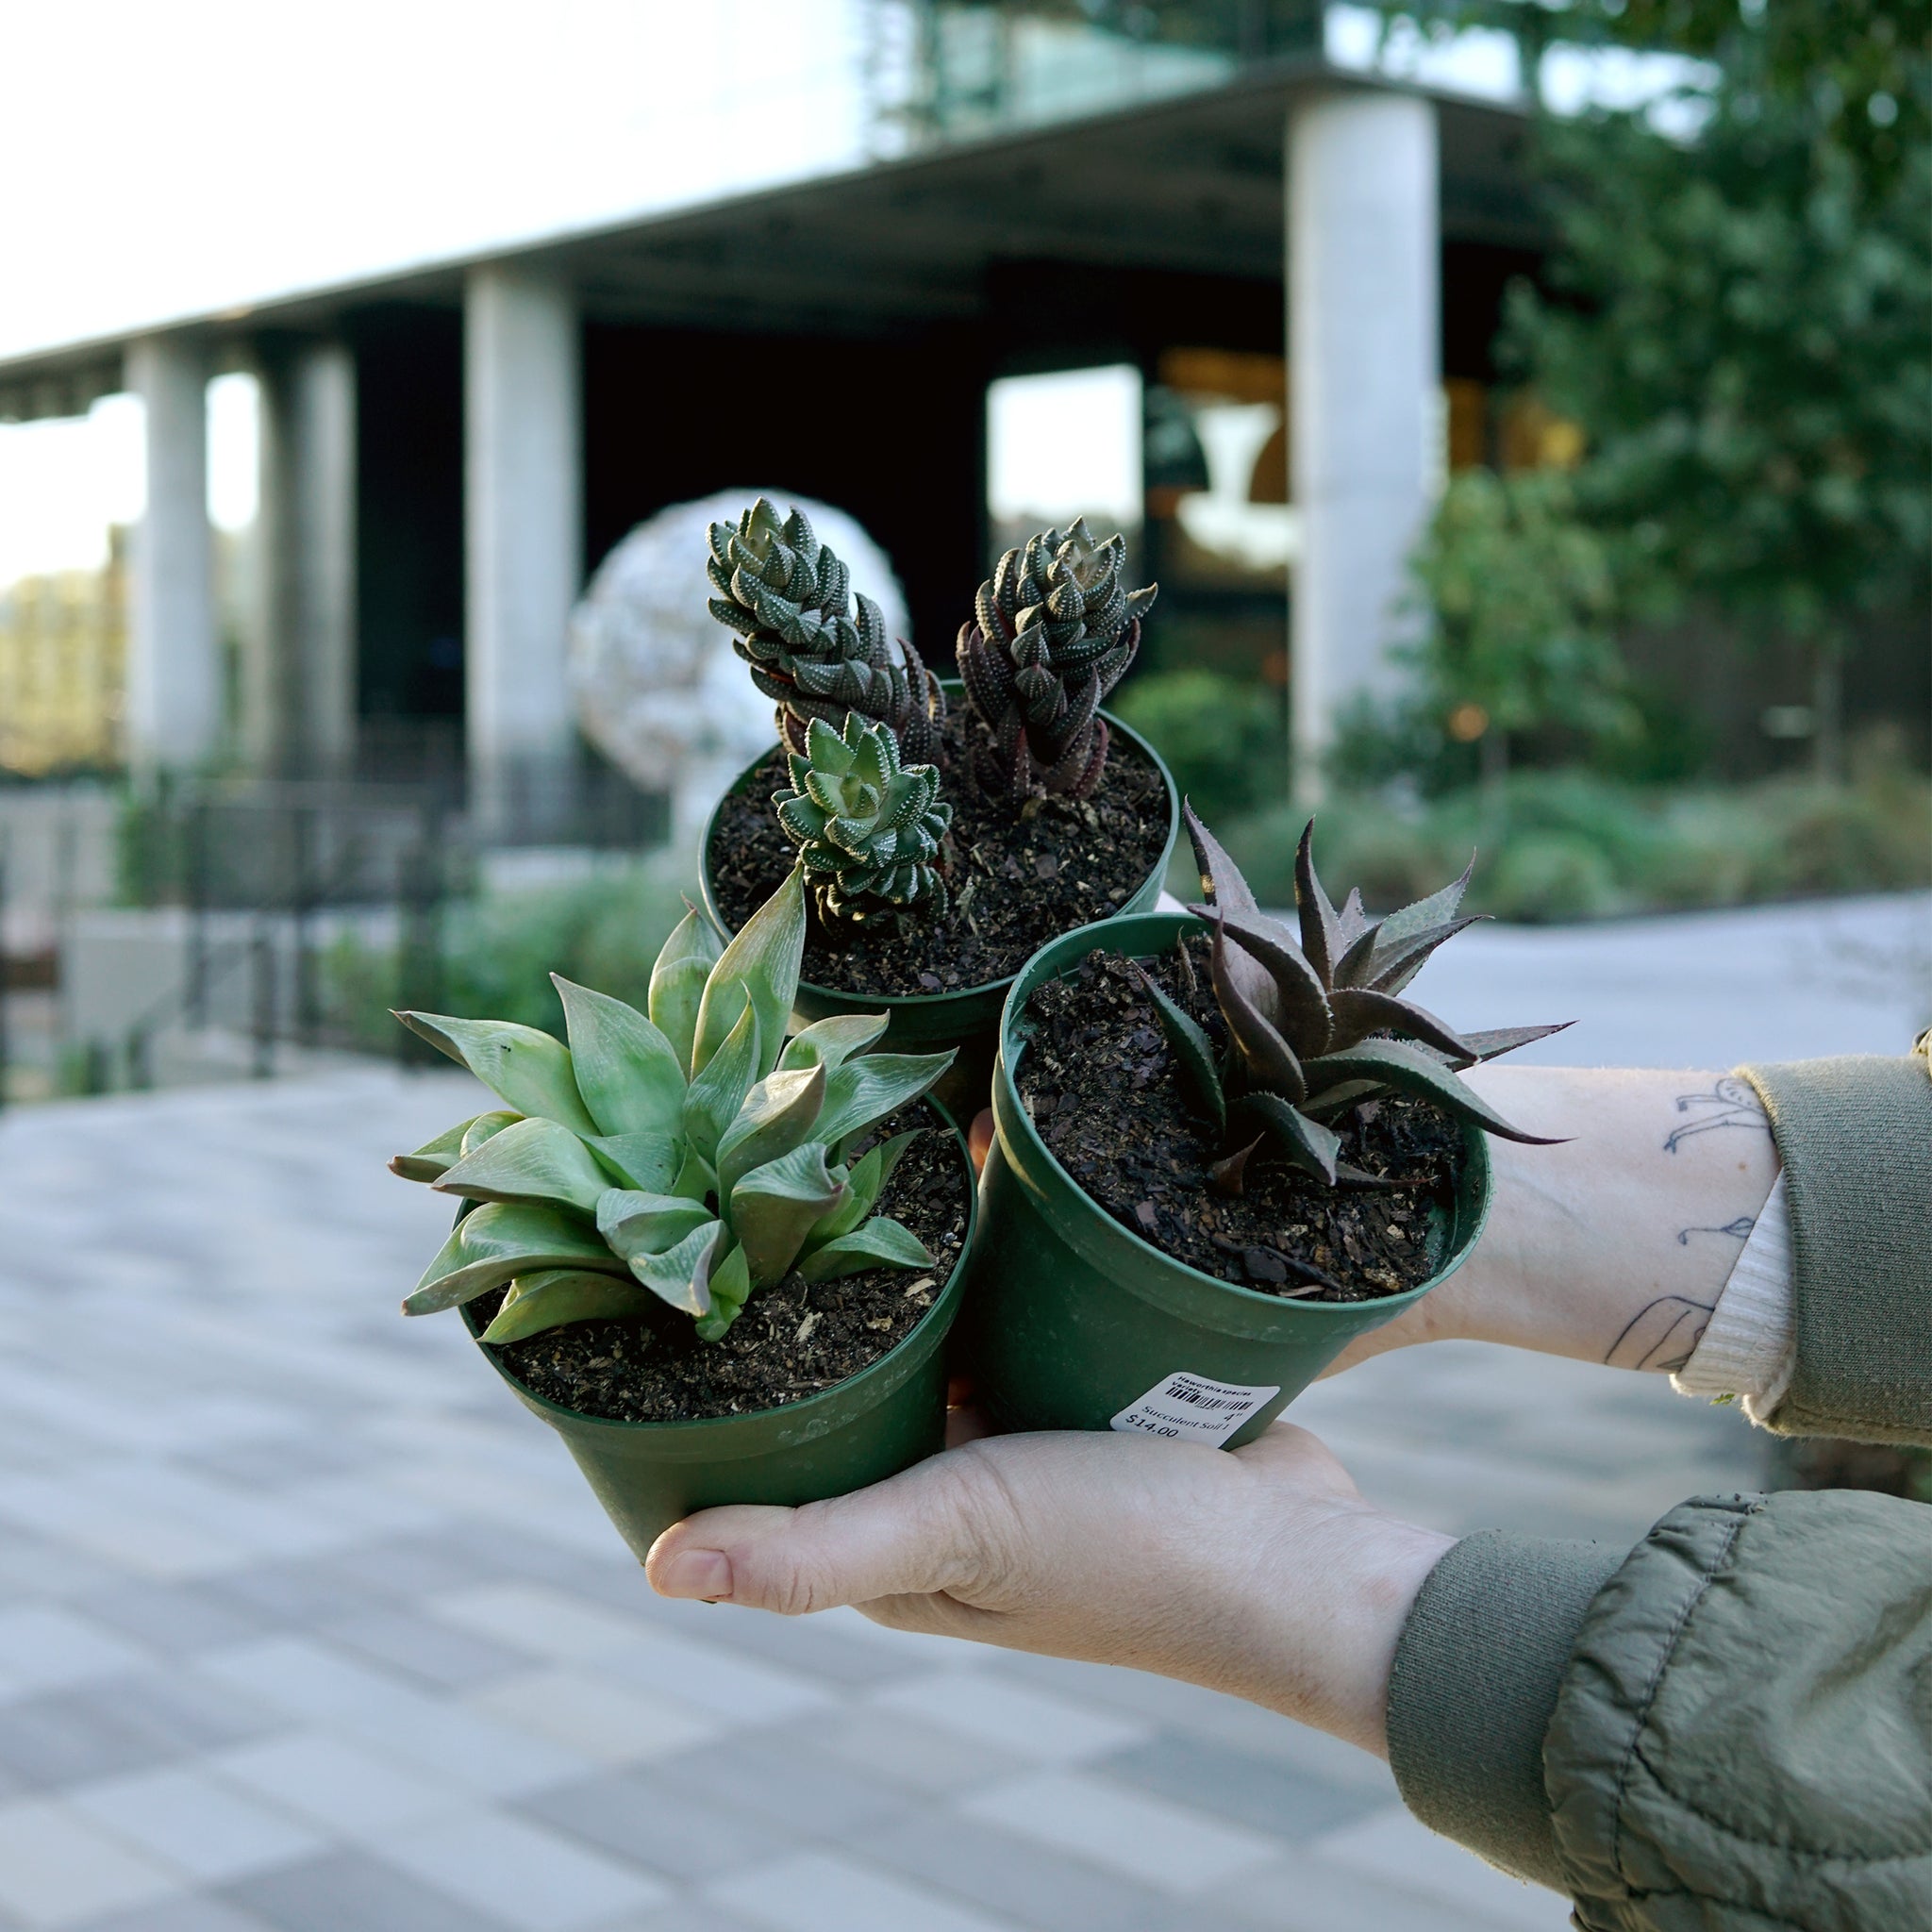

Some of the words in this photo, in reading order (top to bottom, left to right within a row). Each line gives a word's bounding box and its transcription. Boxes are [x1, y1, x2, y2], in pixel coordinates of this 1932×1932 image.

[1177, 1375, 1222, 1392] Haworthia
[1125, 1413, 1179, 1438] $14.00
[1141, 1406, 1199, 1427] Succulent
[1199, 1422, 1224, 1430] Soil
